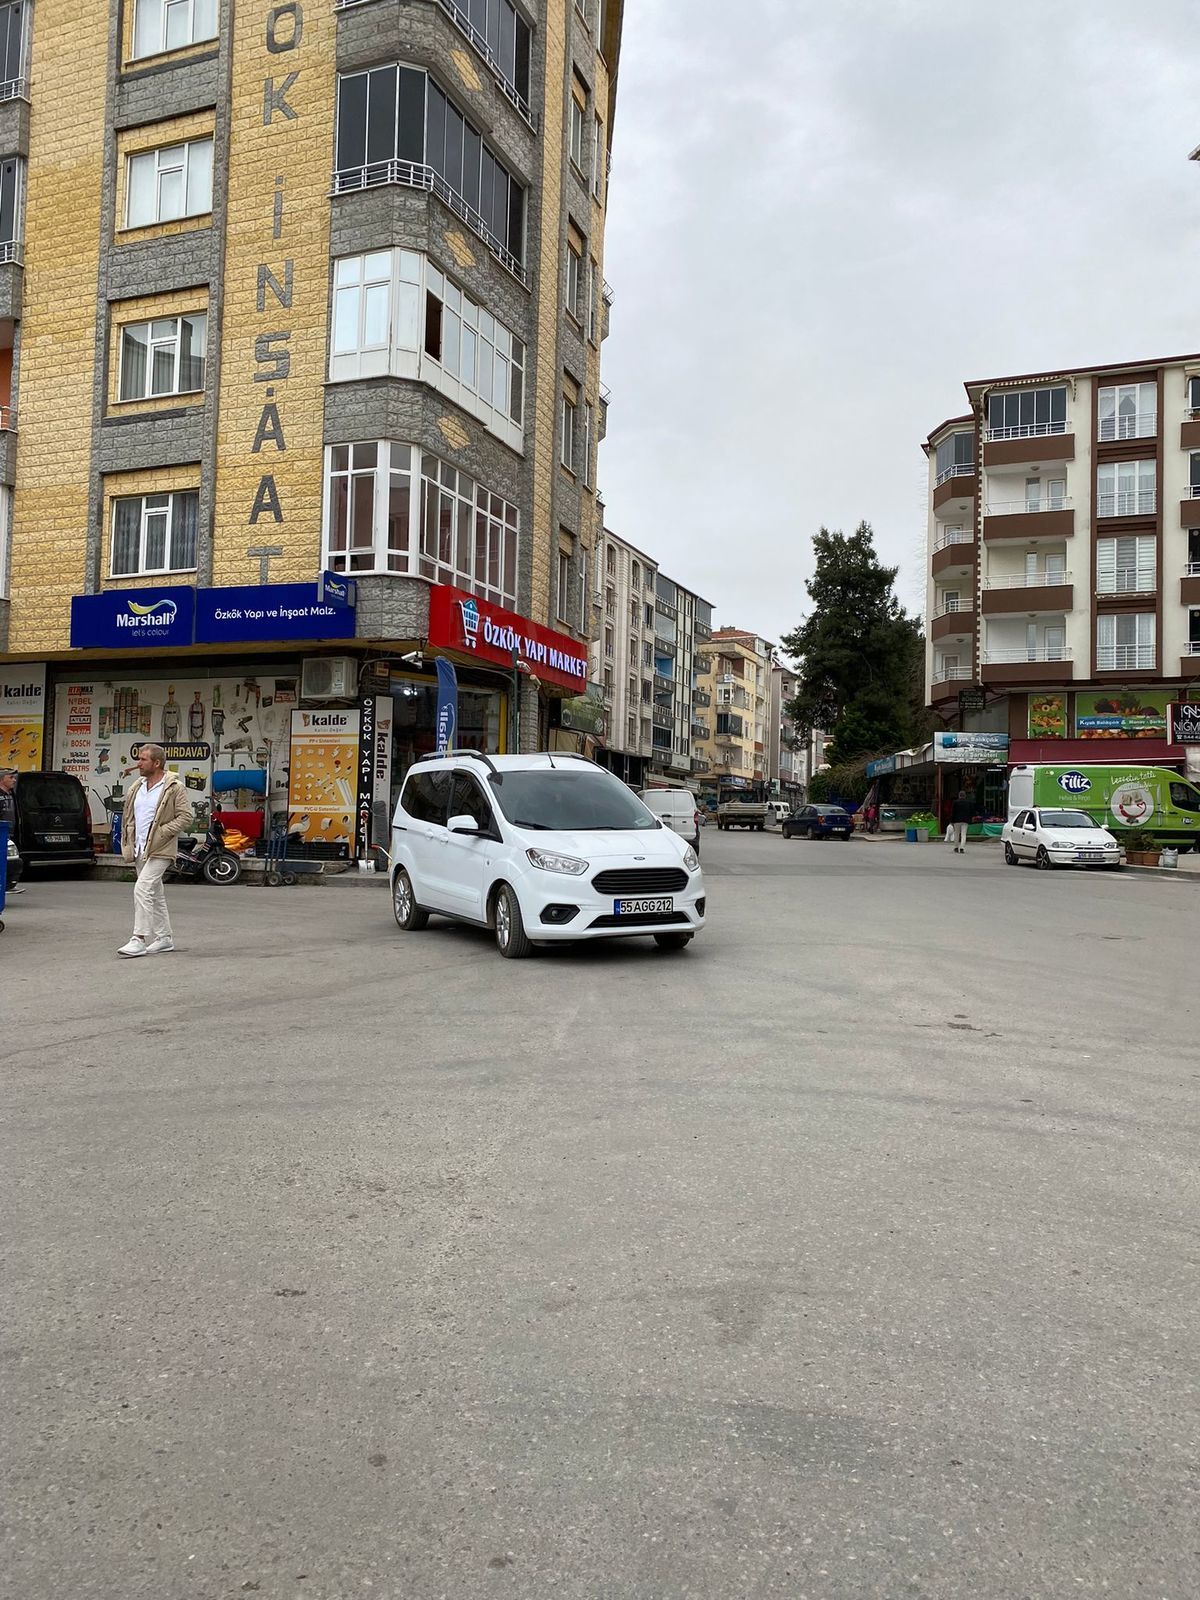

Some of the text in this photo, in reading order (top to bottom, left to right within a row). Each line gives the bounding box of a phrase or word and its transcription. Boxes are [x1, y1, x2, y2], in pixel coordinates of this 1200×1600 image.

[325, 584, 345, 597] Marshall
[116, 612, 170, 627] Marshall
[214, 605, 336, 620] Özkök Yapı ve İnşaat Malz.
[131, 628, 170, 637] let's colour
[483, 616, 588, 679] ÖZKÖK YAPI MARKET
[4, 684, 42, 697] kalde
[311, 714, 347, 726] kalde
[362, 698, 373, 740] ÖZKÖK
[164, 746, 209, 758] HIRDAVAT
[376, 731, 388, 779] kalde
[361, 750, 371, 783] YAPI
[1060, 774, 1091, 790] Filiz
